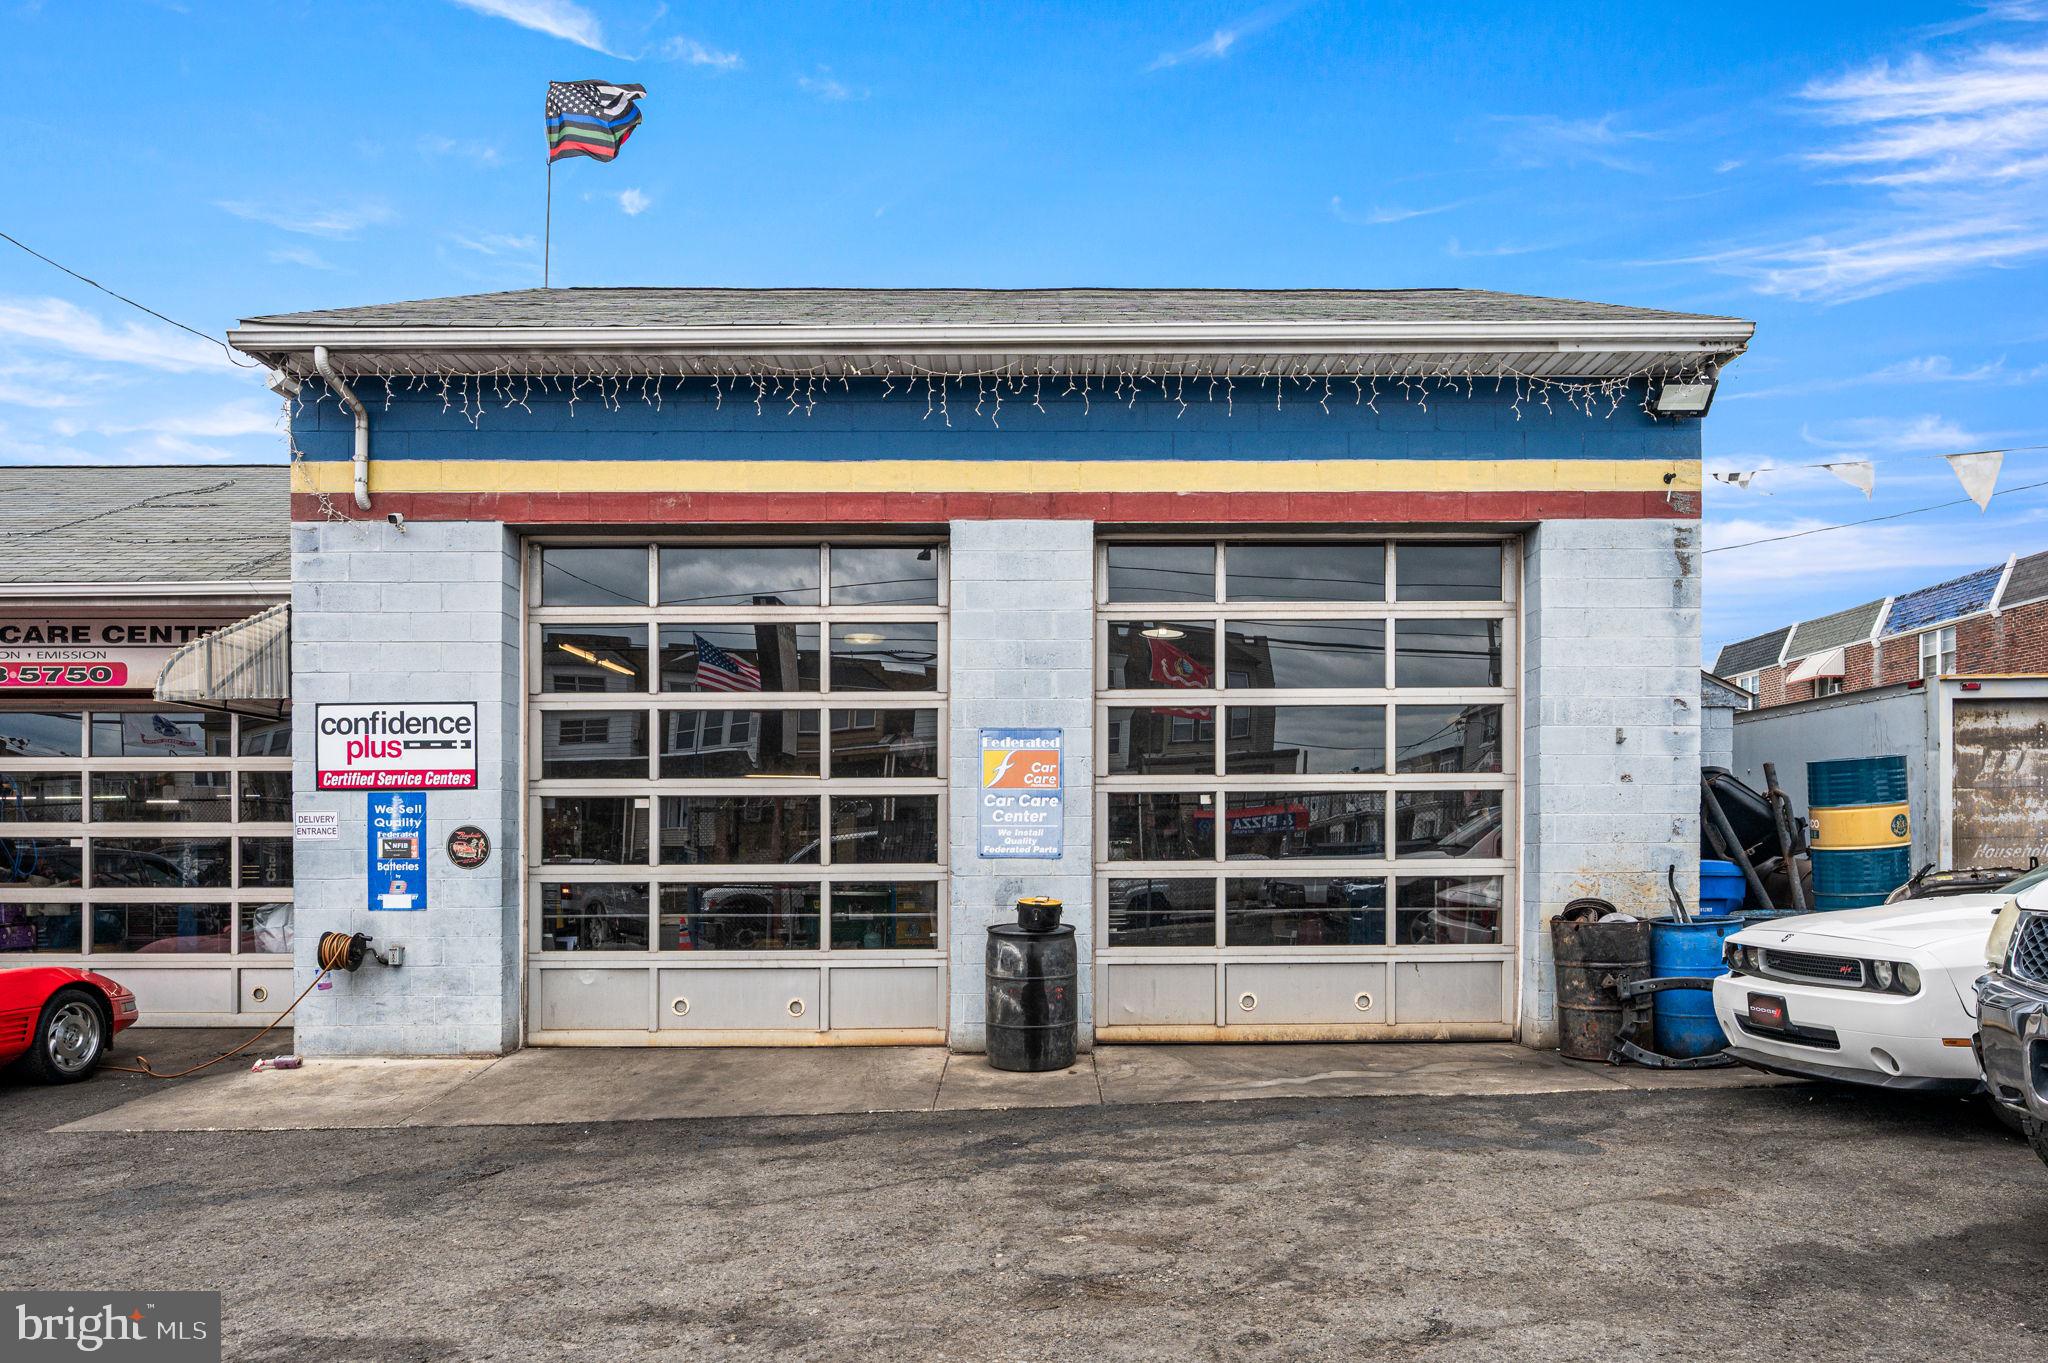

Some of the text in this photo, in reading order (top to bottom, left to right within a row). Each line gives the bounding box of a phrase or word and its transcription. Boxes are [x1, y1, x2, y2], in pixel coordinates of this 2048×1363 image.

[0, 625, 229, 643] CARE CENTE
[37, 651, 107, 659] EMISSION
[321, 711, 471, 735] confidence
[982, 737, 1060, 748] Federated
[347, 735, 403, 765] plus
[1031, 762, 1056, 773] Car
[323, 771, 471, 786] Certified Service Centers
[1023, 773, 1056, 784] Care
[984, 794, 1059, 807] Car Care
[374, 804, 422, 814] We Sell
[298, 815, 336, 823] DELIVERY
[992, 810, 1047, 822] Center
[296, 827, 337, 835] ENTRANCE
[1004, 837, 1037, 845] Quality
[983, 845, 1058, 853] Federated Parts
[377, 861, 420, 871] Batteries
[1750, 1005, 1777, 1015] DODGE
